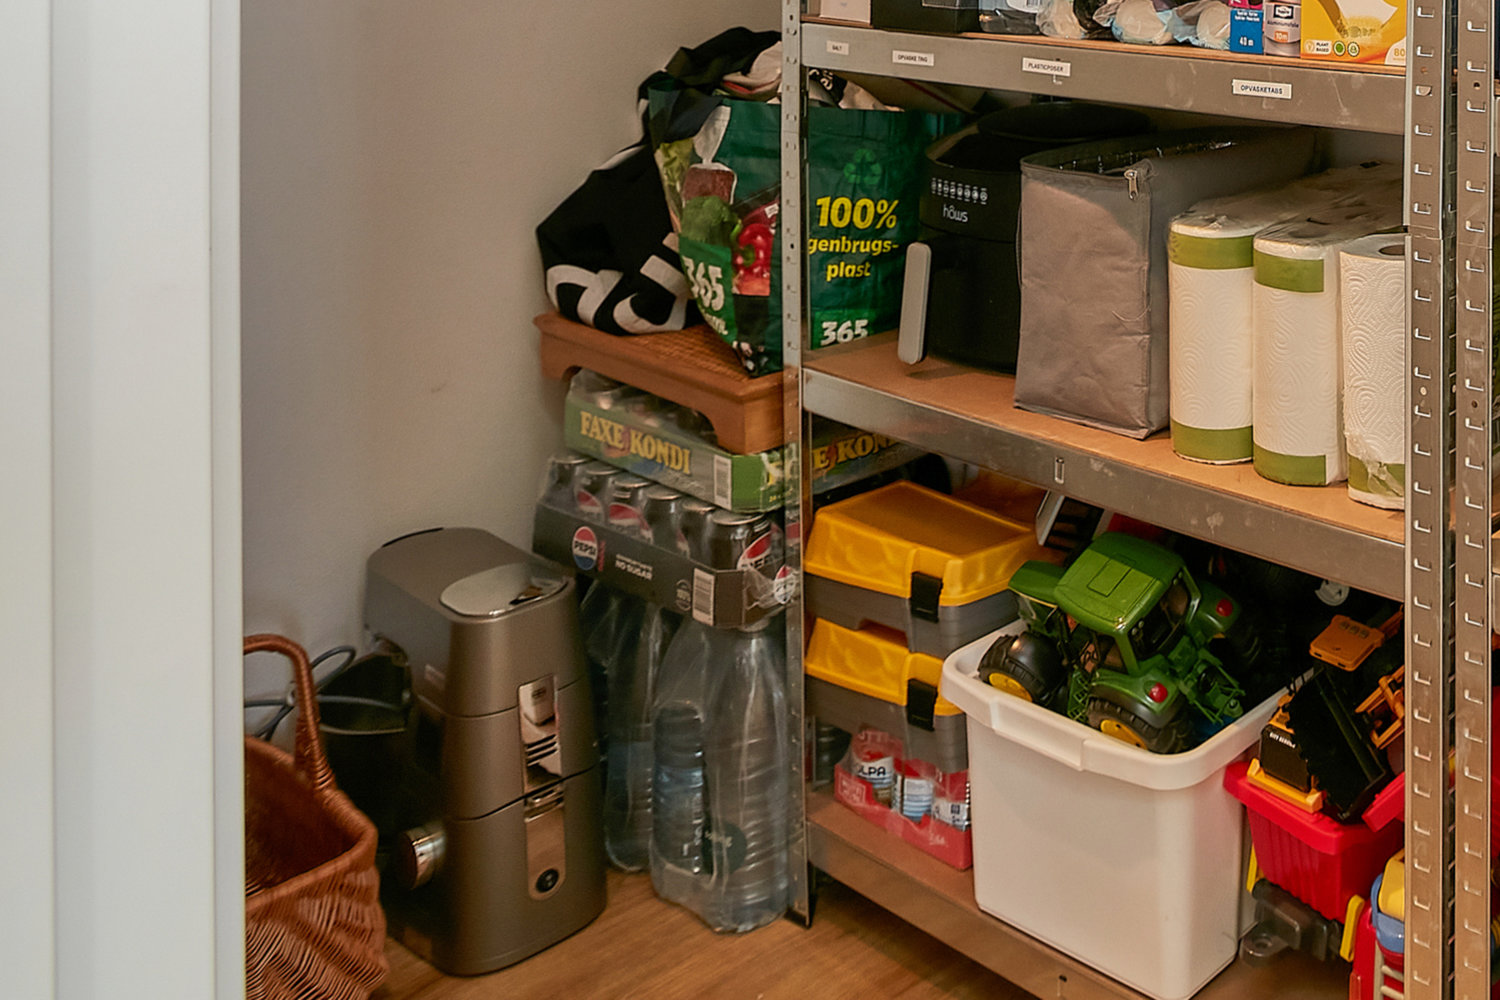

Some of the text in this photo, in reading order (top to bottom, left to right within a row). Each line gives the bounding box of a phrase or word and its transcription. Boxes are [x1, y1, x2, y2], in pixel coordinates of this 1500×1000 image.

[1275, 32, 1288, 41] 10m
[1394, 49, 1406, 57] 80
[816, 196, 899, 229] 100%
[808, 236, 899, 257] genbrugs-
[682, 255, 725, 311] 365
[826, 261, 871, 282] plast
[820, 319, 869, 346] 365
[580, 411, 692, 475] FAXE KONDI
[837, 433, 899, 463] KON
[573, 540, 597, 556] PEPSI
